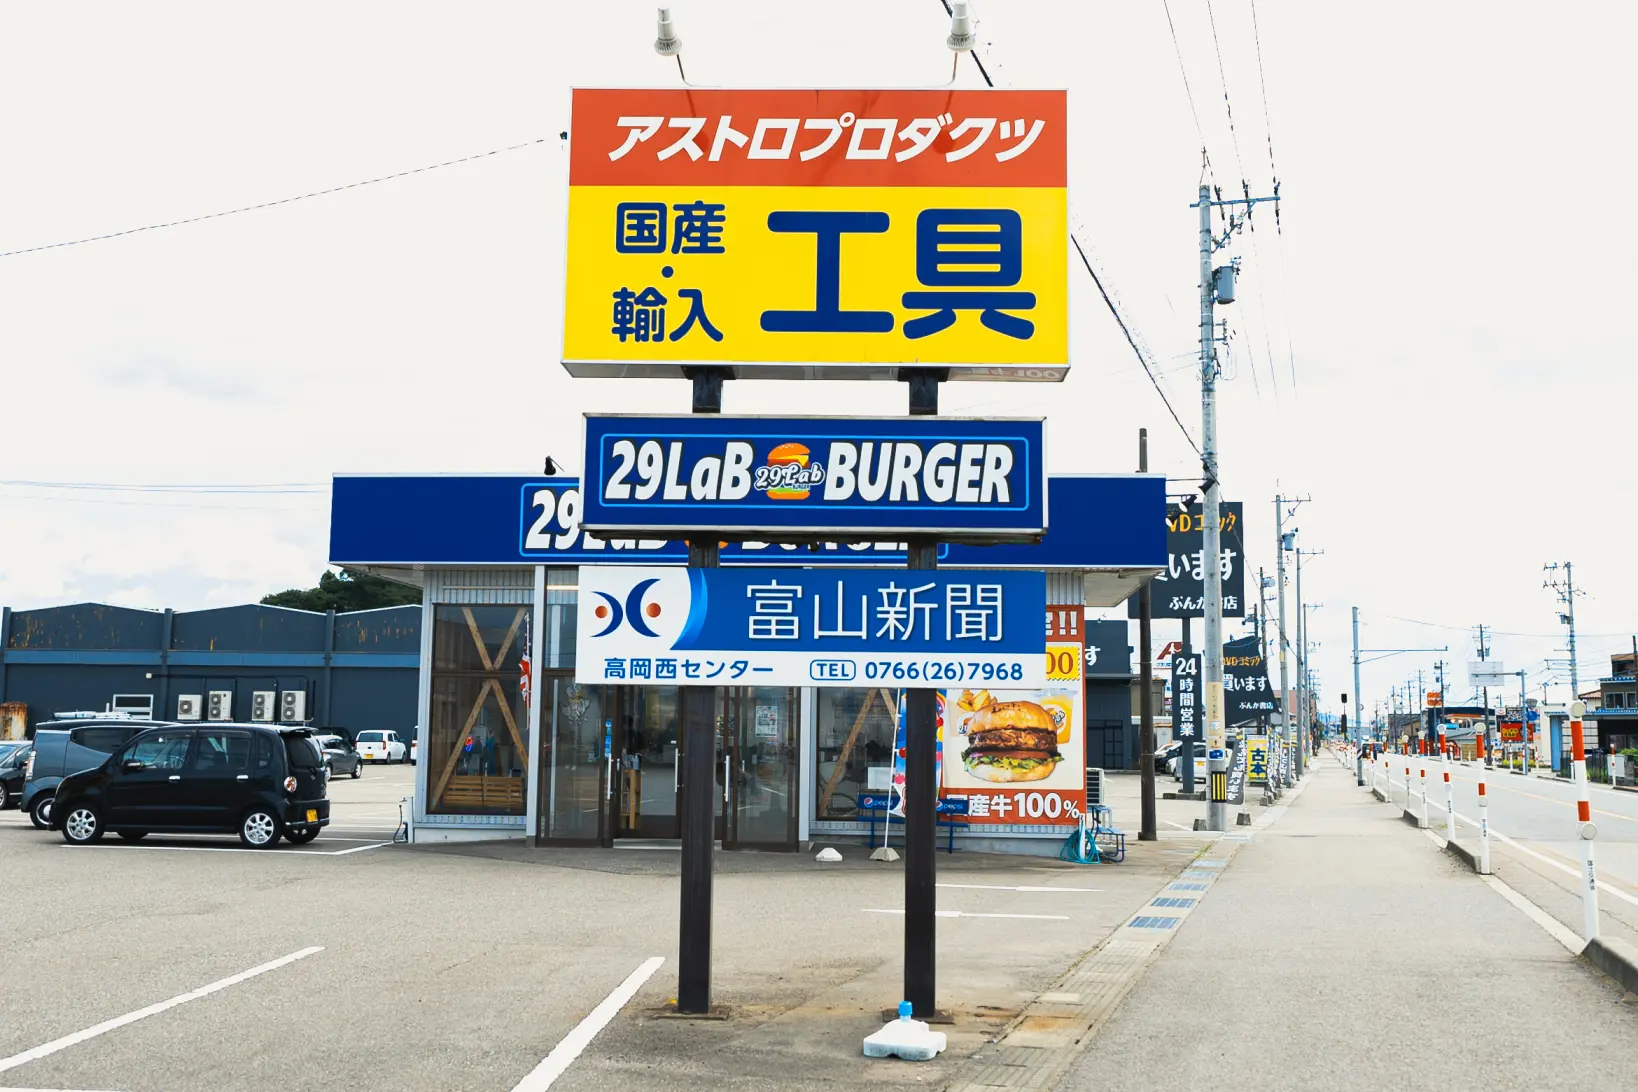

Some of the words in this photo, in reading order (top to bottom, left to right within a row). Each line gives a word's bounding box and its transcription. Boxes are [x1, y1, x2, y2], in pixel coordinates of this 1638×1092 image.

[608, 111, 1046, 163] アストロプロダクツ
[615, 200, 726, 254] 国産
[759, 208, 1037, 340] 工具
[611, 287, 724, 343] 輸入
[605, 440, 754, 500] 29LaB
[823, 442, 1013, 503] BURGER
[755, 463, 824, 489] 29Lab
[1155, 548, 1237, 582] います
[746, 579, 1003, 642] 富山新聞
[603, 657, 774, 680] 高岡西センター
[816, 663, 852, 679] TEL
[865, 661, 1023, 681] 0766(26)7968
[1250, 748, 1267, 776] 古本
[946, 792, 1080, 819] 産牛100%
